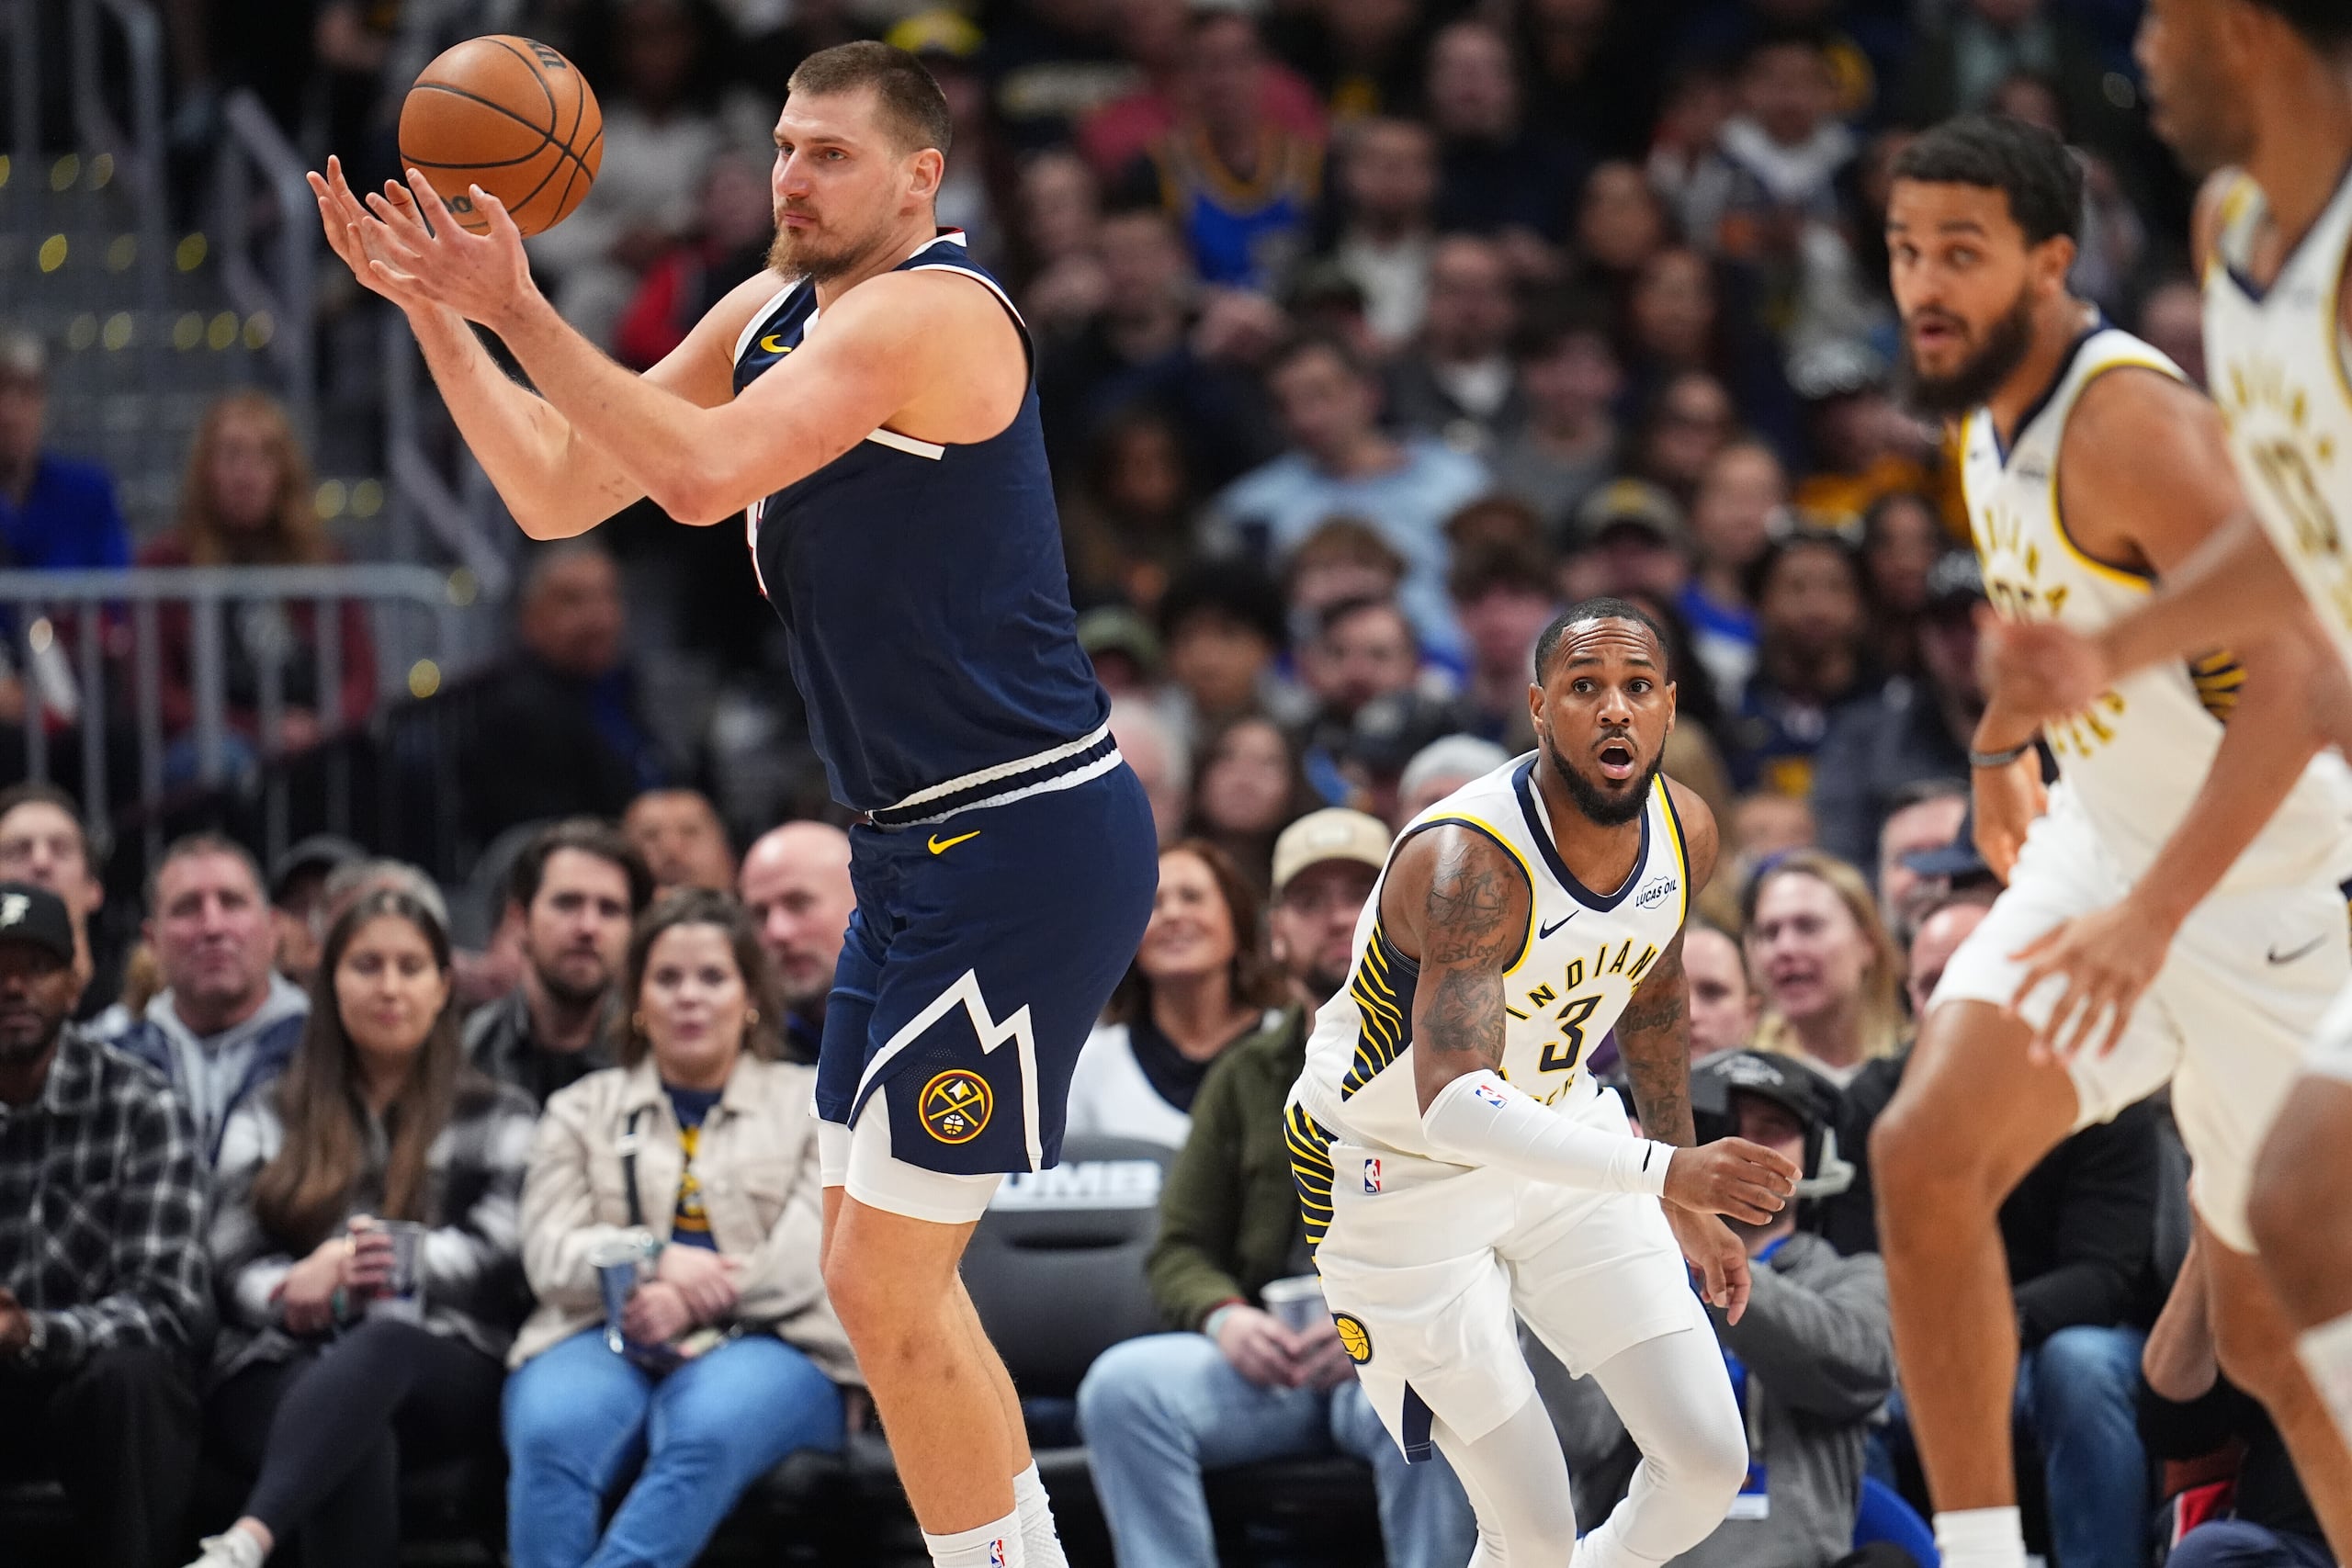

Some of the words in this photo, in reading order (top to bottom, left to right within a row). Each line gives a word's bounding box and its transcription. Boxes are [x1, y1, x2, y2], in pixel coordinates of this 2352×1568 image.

[1635, 885, 1662, 908] LUCAS
[1664, 879, 1677, 895] OIL
[1505, 937, 1657, 1021] INDIAN
[1538, 993, 1605, 1074] 3
